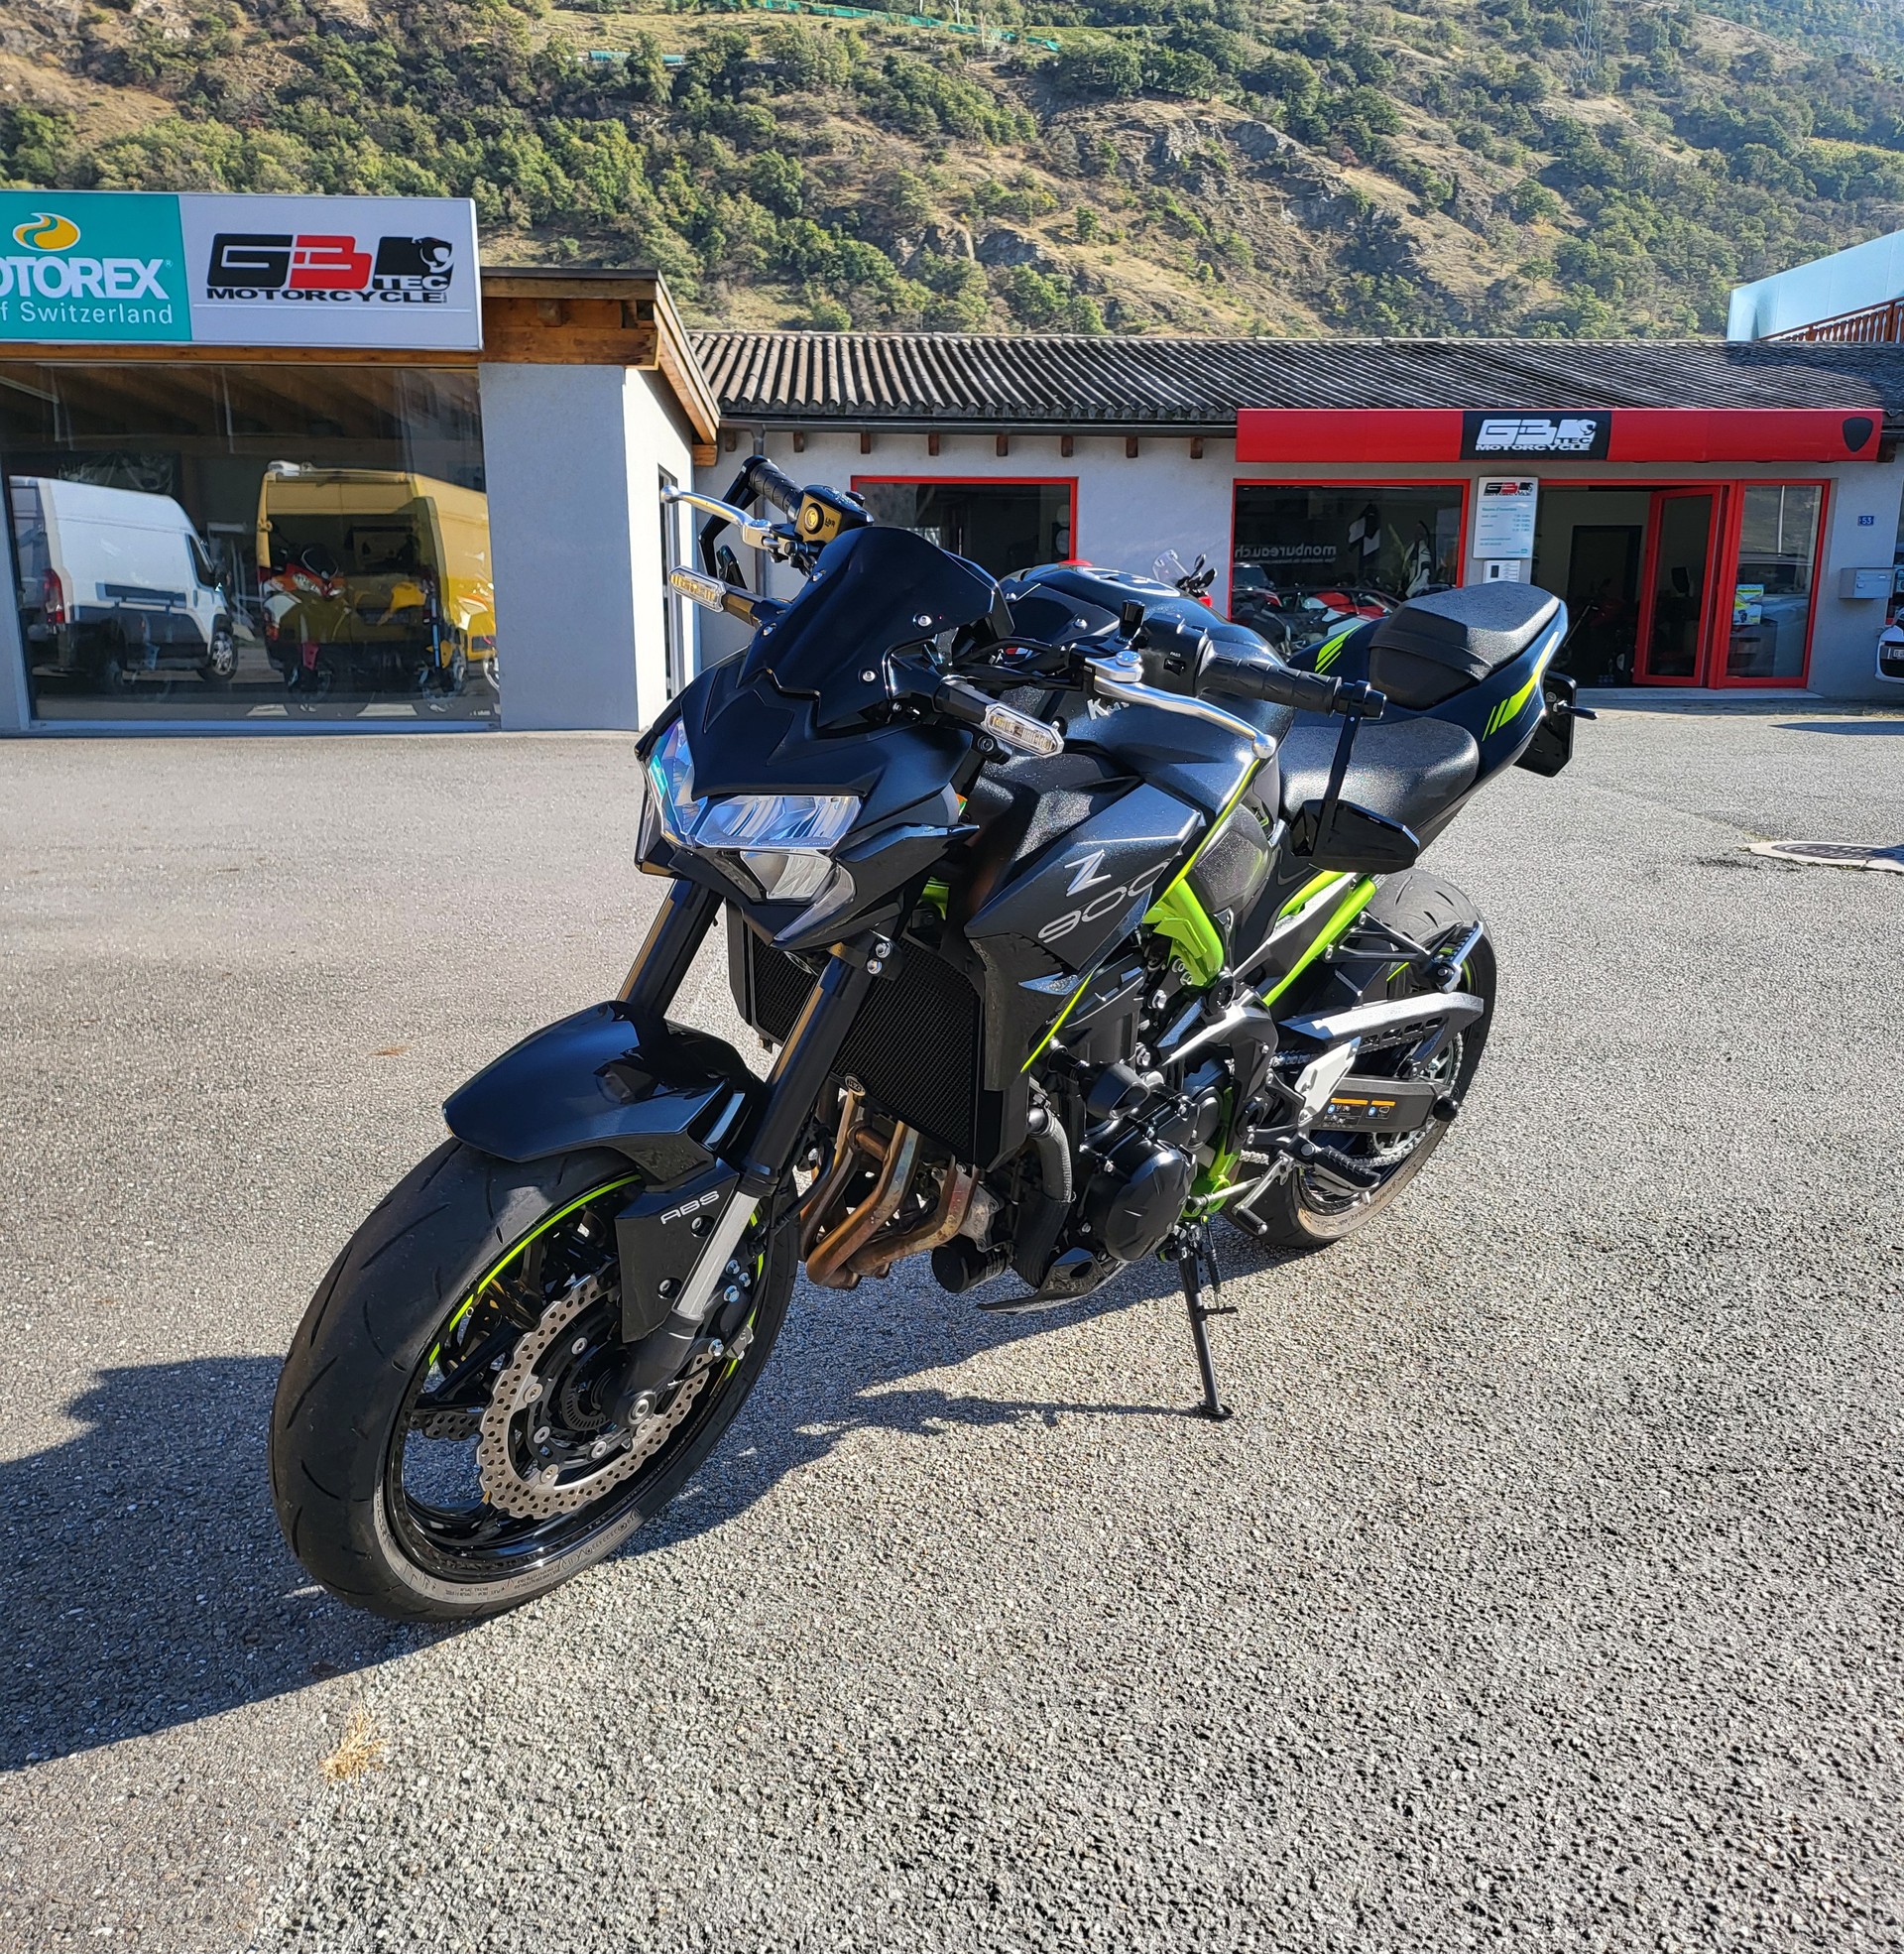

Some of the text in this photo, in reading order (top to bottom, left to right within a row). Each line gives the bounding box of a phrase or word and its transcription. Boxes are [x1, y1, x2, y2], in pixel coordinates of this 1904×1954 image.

[0, 256, 170, 300] TOREX
[374, 274, 449, 291] TEC
[0, 301, 174, 324] f Switzerland
[206, 288, 442, 304] MOTORCYCLE
[1064, 848, 1112, 897] Z
[1038, 858, 1172, 943] 900
[659, 1190, 720, 1225] ABS
